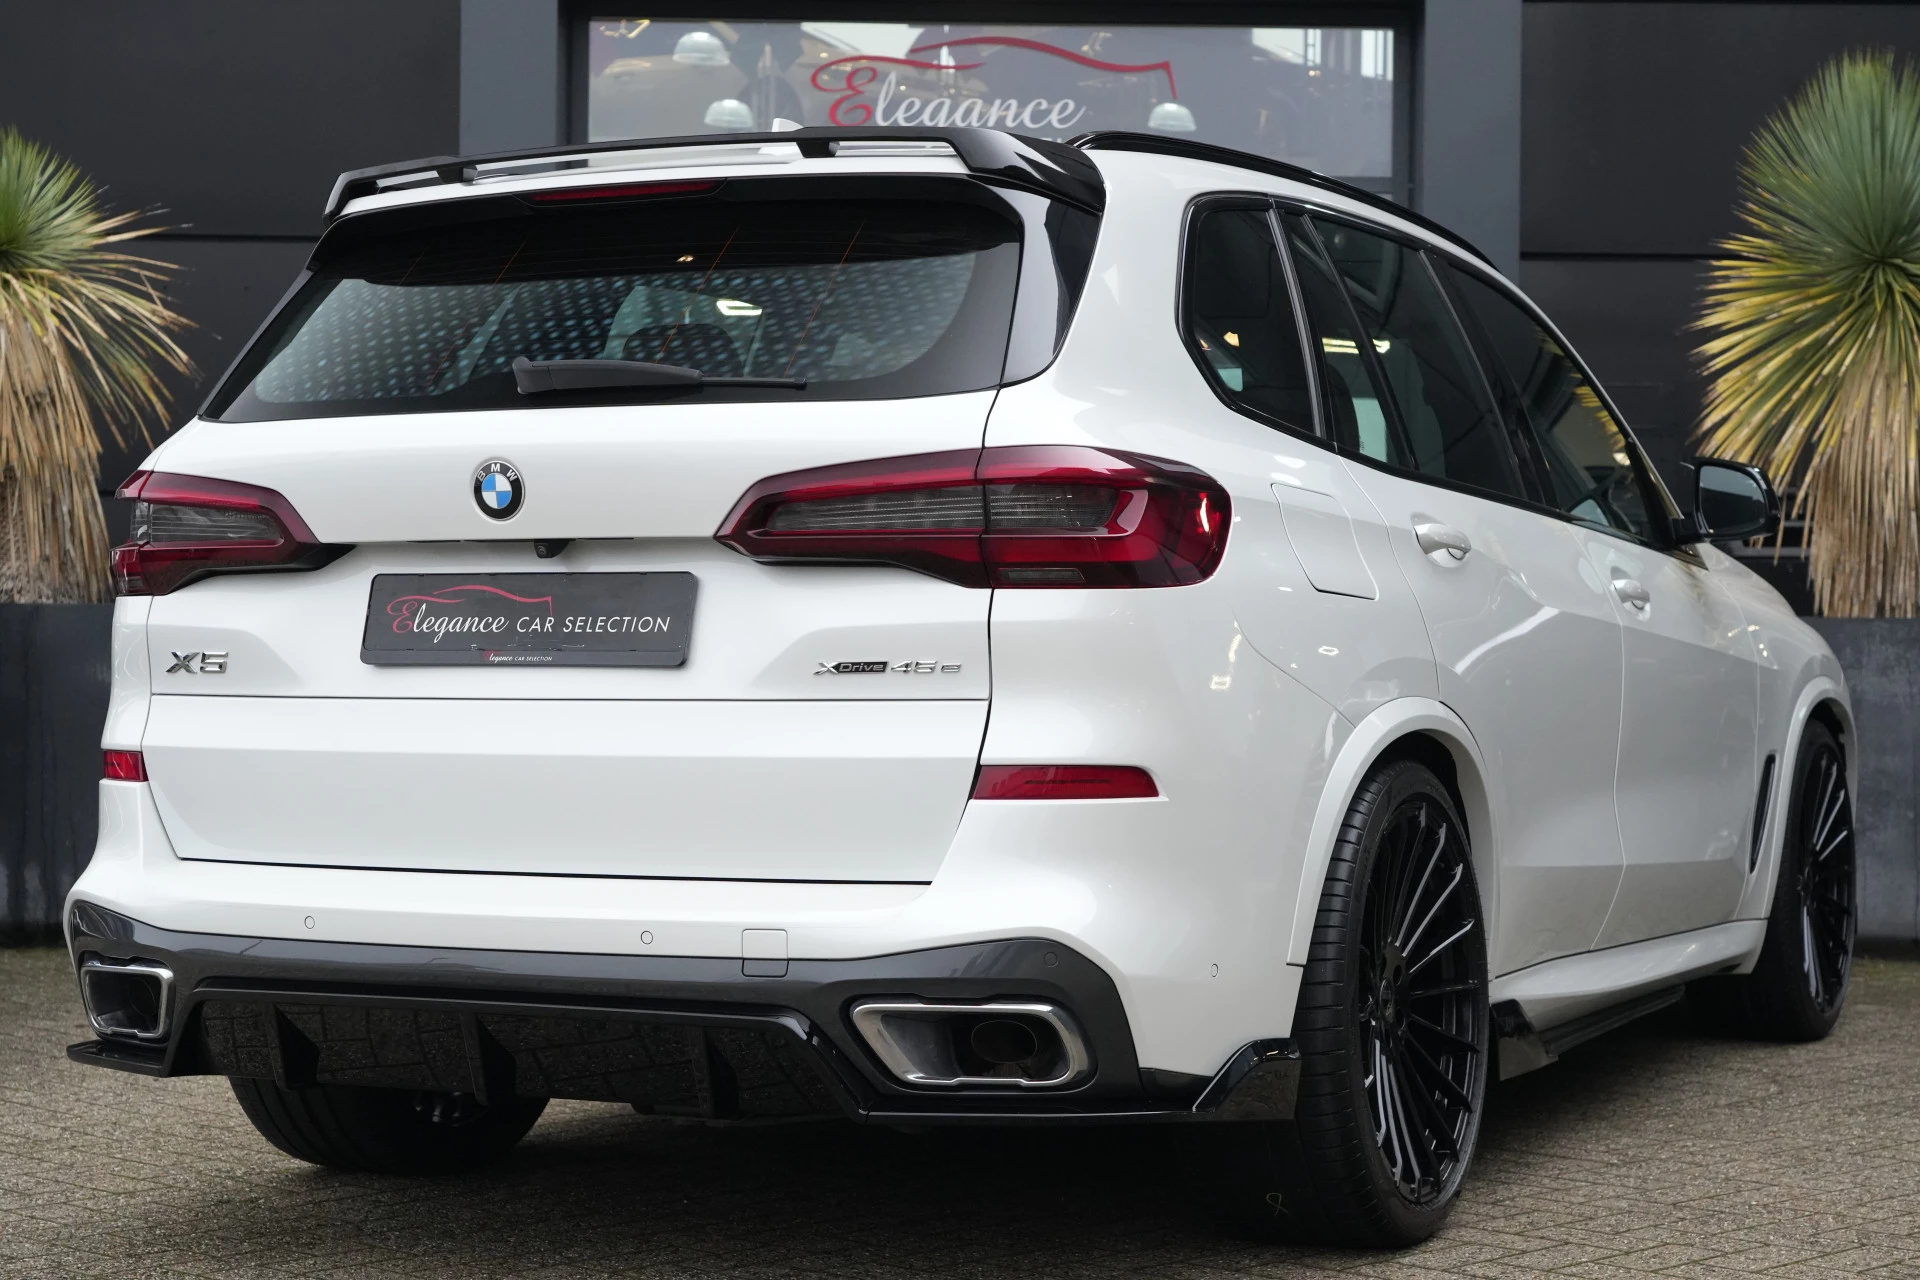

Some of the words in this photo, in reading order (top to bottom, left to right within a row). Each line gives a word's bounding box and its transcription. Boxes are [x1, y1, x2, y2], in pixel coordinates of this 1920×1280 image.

[811, 54, 1087, 129] Elegance
[477, 462, 518, 482] BMW
[387, 595, 510, 644] Elegance
[516, 616, 555, 633] CAR
[562, 616, 671, 633] SELECTION
[165, 651, 229, 674] X5
